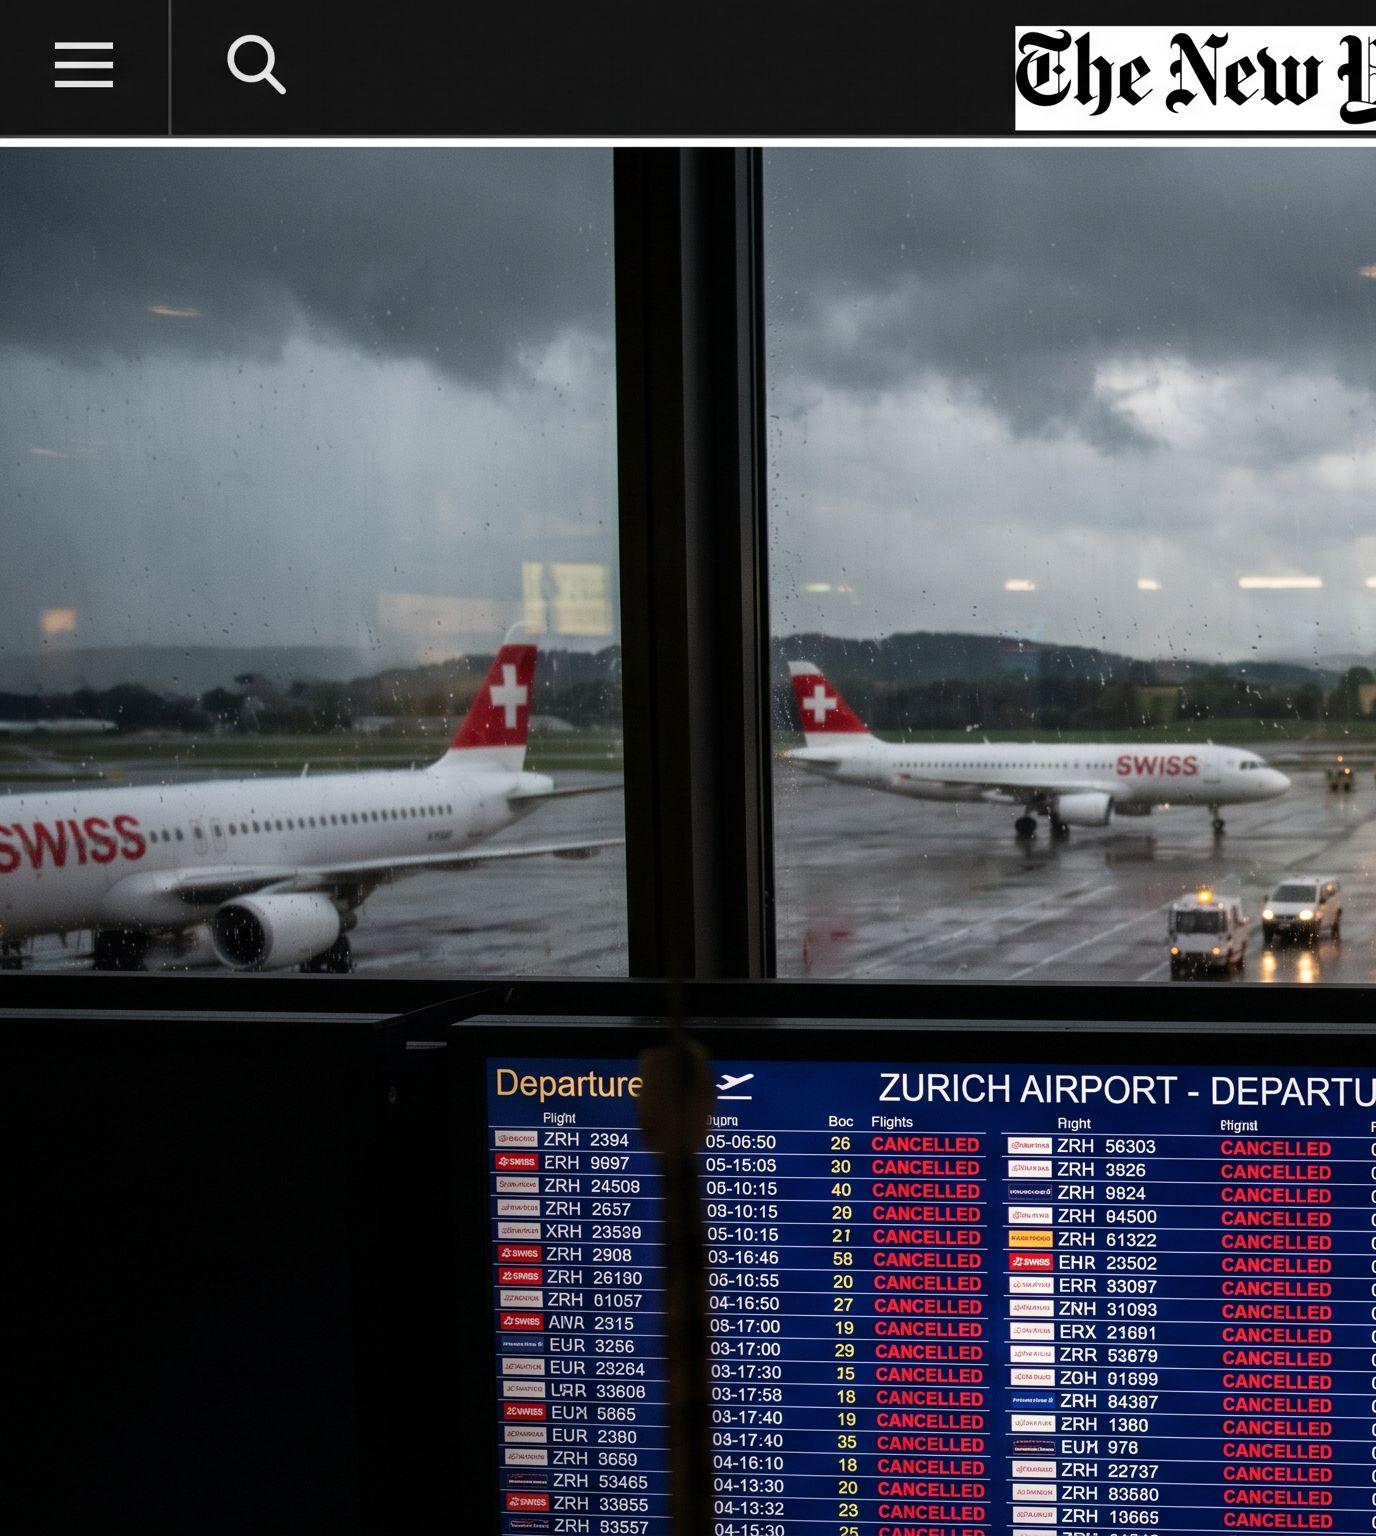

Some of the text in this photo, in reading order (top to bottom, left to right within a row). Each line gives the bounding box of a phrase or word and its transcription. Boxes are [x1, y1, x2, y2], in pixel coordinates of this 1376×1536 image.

[1117, 754, 1199, 777] SWISS
[0, 814, 146, 874] SWISS
[880, 1074, 1009, 1102] ZURICH
[1020, 1075, 1177, 1104] AIRPORT
[829, 1116, 853, 1126] Boc
[872, 1116, 913, 1129] Flights
[544, 1132, 579, 1146] ZRH
[591, 1133, 629, 1146] 2394
[706, 1135, 776, 1149] 05-06:50
[831, 1137, 850, 1150] 26
[872, 1137, 979, 1152] CANCELLED
[1057, 1139, 1093, 1152] ZRH
[1106, 1140, 1155, 1153] 56303
[1221, 1141, 1331, 1156] CANCELLED
[872, 1160, 979, 1175] CANCELLED
[1058, 1162, 1094, 1176] ZRH
[1221, 1165, 1331, 1180] CANCELLED
[545, 1179, 579, 1192] ZRH
[832, 1183, 851, 1196] 40
[873, 1183, 980, 1198] CANCELLED
[1058, 1186, 1094, 1199] ZRH
[1106, 1187, 1145, 1200] 9824
[1222, 1188, 1331, 1203] CANCELLED
[546, 1202, 580, 1215] ZRH
[593, 1203, 630, 1216] 2657
[873, 1206, 980, 1221] CANCELLED
[1058, 1209, 1094, 1223] ZRH
[1222, 1211, 1331, 1226] CANCELLED
[546, 1224, 581, 1238] XRH
[708, 1227, 778, 1241] 05-10:15
[833, 1229, 850, 1242] 21
[873, 1230, 980, 1244] CANCELLED
[1059, 1232, 1094, 1246] ZRH
[1107, 1233, 1156, 1247] 61322
[1222, 1234, 1331, 1250] CANCELLED
[547, 1247, 581, 1261] ZRH
[593, 1248, 631, 1261] 2908
[709, 1250, 778, 1264] 03-16:46
[834, 1252, 852, 1265] 58
[874, 1252, 981, 1268] CANCELLED
[1107, 1256, 1156, 1270] 23502
[1222, 1258, 1331, 1273] CANCELLED
[548, 1269, 582, 1283] ZRH
[834, 1275, 853, 1288] 20
[874, 1276, 981, 1291] CANCELLED
[1060, 1278, 1096, 1292] ERR
[1107, 1280, 1157, 1293] 33097
[1222, 1282, 1331, 1296] CANCELLED
[548, 1293, 582, 1306] ZRH
[710, 1296, 779, 1310] 04-16:50
[834, 1298, 853, 1311] 27
[875, 1299, 982, 1314] CANCELLED
[1108, 1303, 1157, 1316] 31093
[1222, 1304, 1331, 1320] CANCELLED
[836, 1321, 853, 1334] 19
[875, 1322, 982, 1336] CANCELLED
[1061, 1325, 1096, 1338] ERX
[1222, 1328, 1331, 1343] CANCELLED
[550, 1338, 585, 1351] EUR
[711, 1342, 780, 1356] 03-17:00
[835, 1344, 854, 1357] 29
[876, 1345, 982, 1360] CANCELLED
[1060, 1348, 1097, 1361] ZRR
[1108, 1349, 1157, 1362] 53679
[1223, 1351, 1332, 1366] CANCELLED
[551, 1361, 585, 1374] EUR
[712, 1365, 781, 1378] 03-17:30
[876, 1367, 982, 1383] CANCELLED
[1223, 1374, 1331, 1389] CANCELLED
[712, 1388, 983, 1406] 03-17:58 18 CANCELLED
[1061, 1394, 1096, 1407] ZRH
[1223, 1397, 1331, 1413] CANCELLED
[713, 1410, 983, 1429] 03-17:40 19 CANCELLED
[1223, 1420, 1331, 1436] CANCELLED
[553, 1429, 587, 1442] EUR
[598, 1430, 636, 1444] 2380
[838, 1435, 856, 1448] 35
[878, 1437, 984, 1452] CANCELLED
[1223, 1443, 1332, 1459] CANCELLED
[553, 1451, 587, 1464] ZRH
[714, 1456, 783, 1470] 04-16:10
[839, 1458, 857, 1471] 18
[878, 1459, 984, 1475] CANCELLED
[1062, 1463, 1097, 1476] ZRH
[1109, 1464, 1158, 1478] 22737
[1224, 1467, 1332, 1482] CANCELLED
[554, 1474, 587, 1487] ZRH
[600, 1475, 647, 1489] 53465
[714, 1478, 783, 1492] 04-13:30
[839, 1481, 857, 1494] 20
[878, 1482, 984, 1497] CANCELLED
[1062, 1486, 1097, 1500] ZRH
[1224, 1490, 1332, 1505] CANCELLED
[554, 1497, 588, 1509] ZRH
[839, 1504, 858, 1517] 23
[879, 1505, 985, 1520] CANCELLED
[555, 1519, 588, 1532] ZRH
[840, 1527, 859, 1536] 25
[1062, 1509, 1097, 1523] ZRH
[1224, 1513, 1332, 1528] CANCELLED
